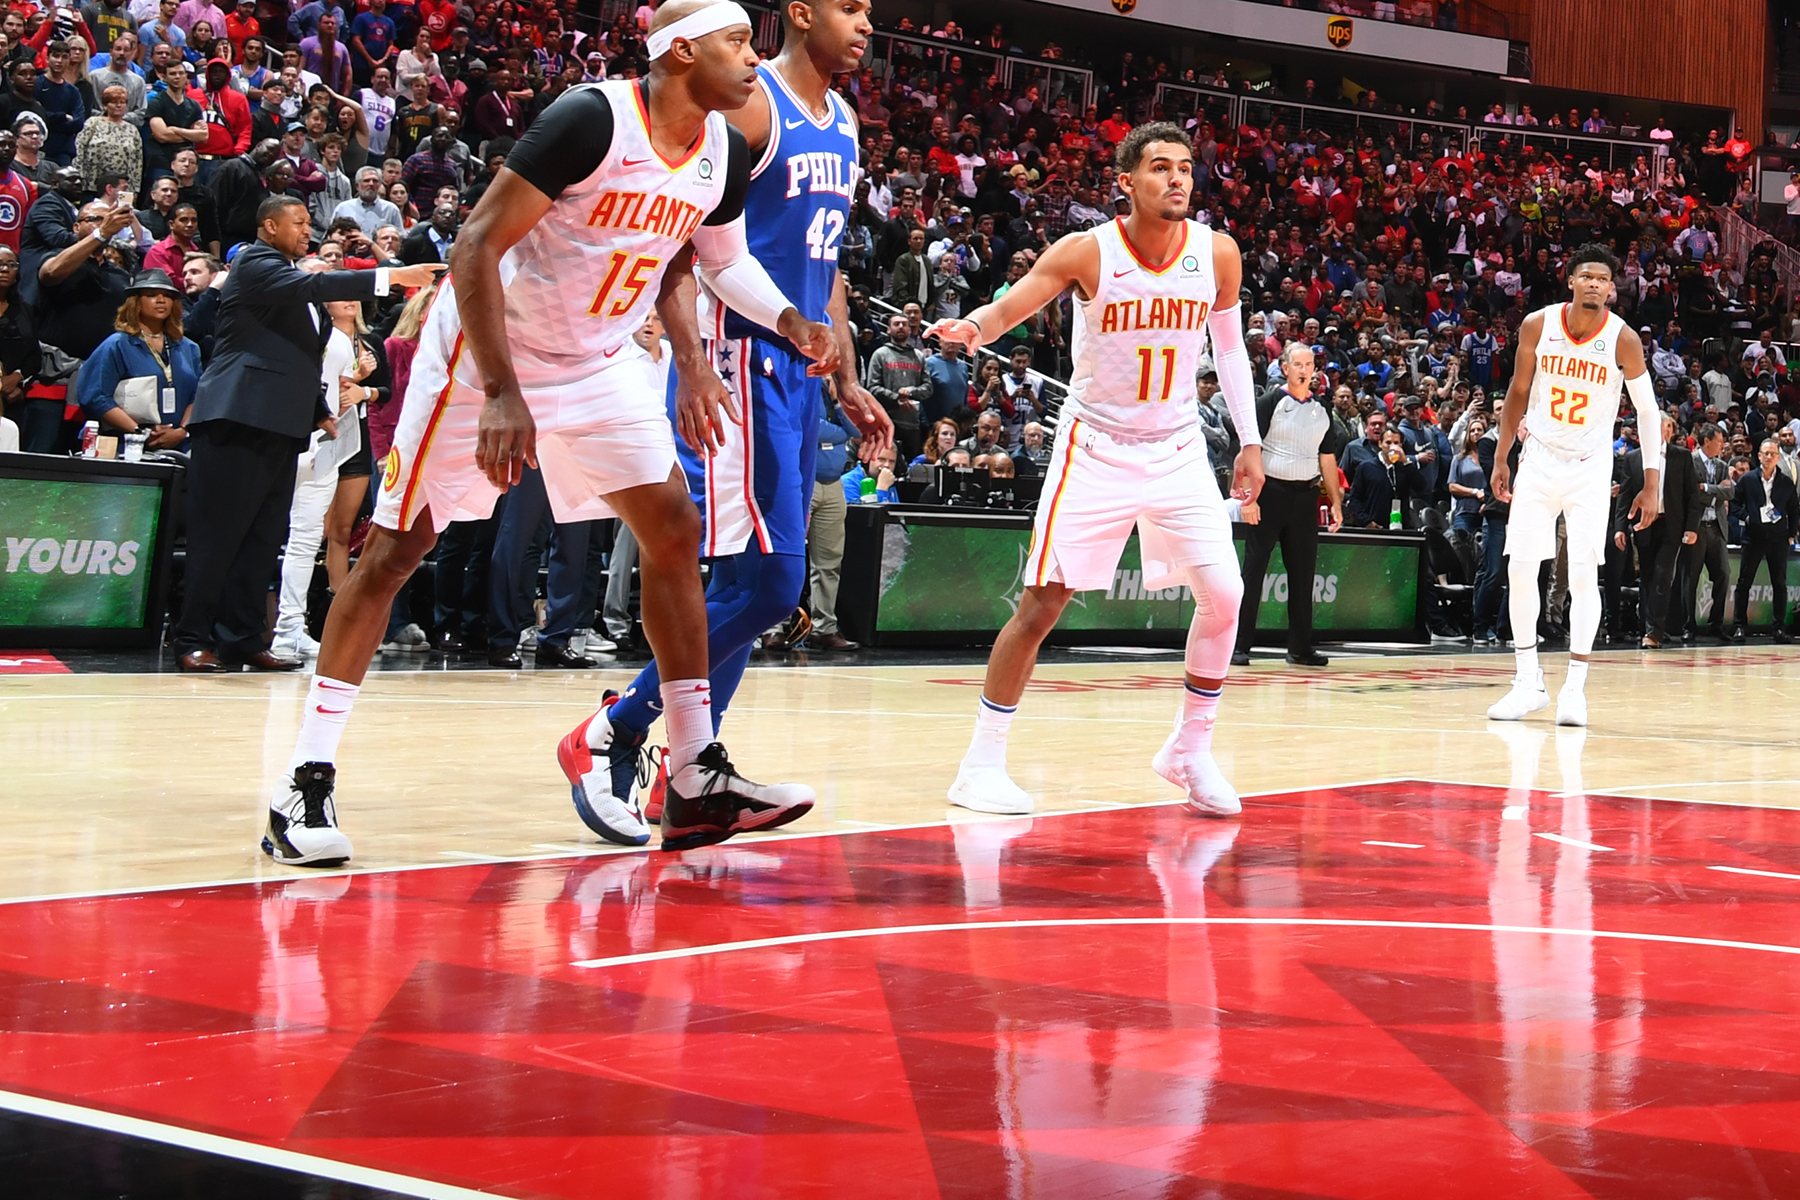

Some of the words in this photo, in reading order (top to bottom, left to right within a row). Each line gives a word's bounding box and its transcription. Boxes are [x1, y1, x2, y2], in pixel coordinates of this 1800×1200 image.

[1330, 25, 1350, 43] ups
[374, 115, 386, 132] 6
[586, 190, 704, 244] ATLANTA
[805, 207, 845, 261] 42
[586, 250, 661, 319] 15
[1101, 297, 1209, 335] ATLANTA
[1136, 346, 1177, 403] 11
[1540, 354, 1608, 386] ATLANTA
[1550, 386, 1590, 426] 22
[5, 537, 140, 576] YOURS
[1261, 573, 1338, 602] YORS
